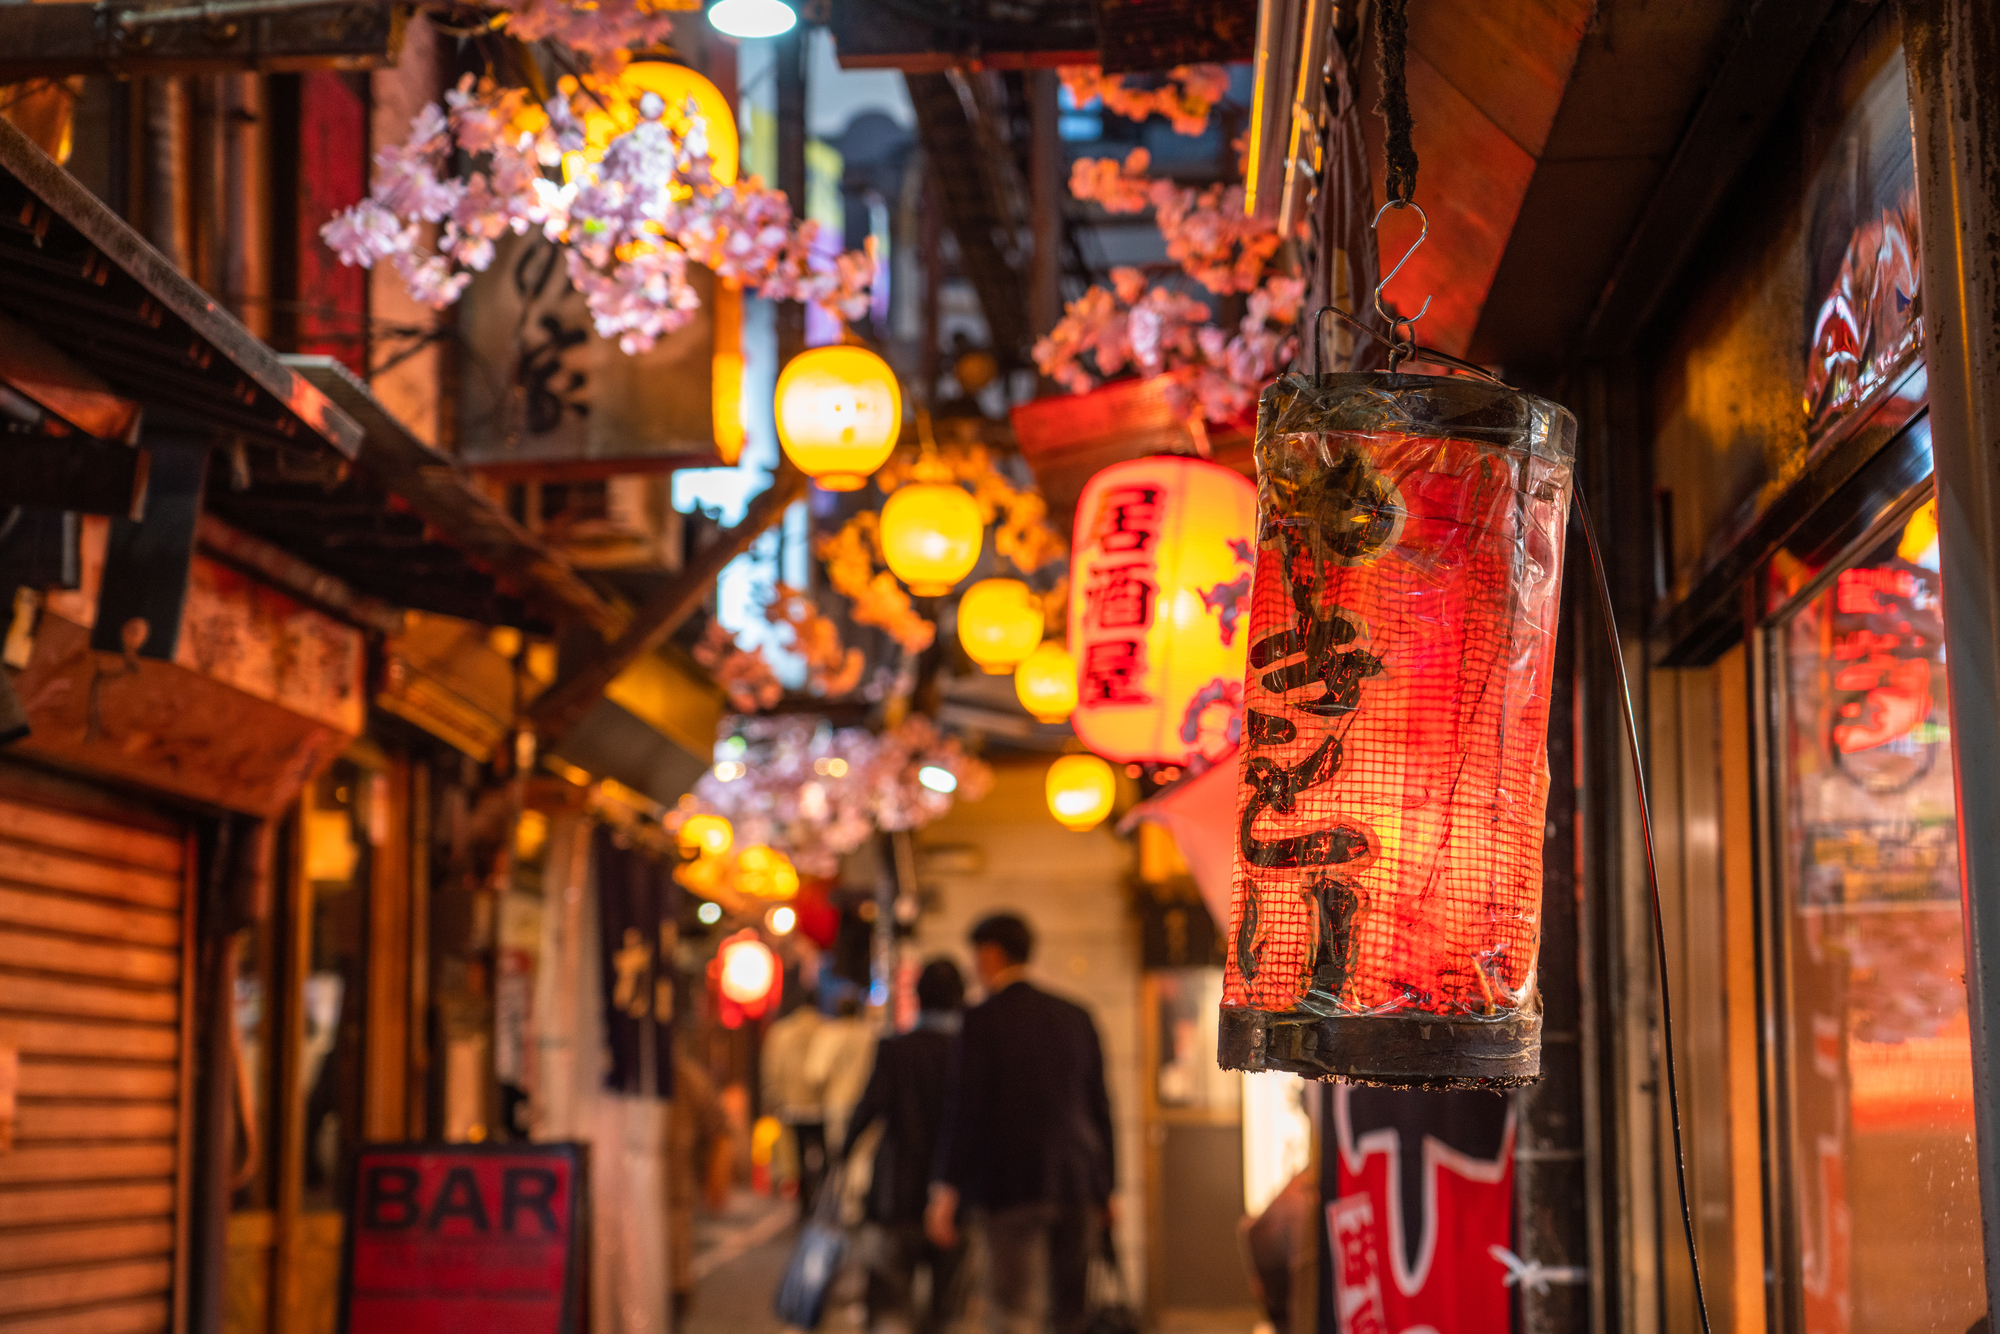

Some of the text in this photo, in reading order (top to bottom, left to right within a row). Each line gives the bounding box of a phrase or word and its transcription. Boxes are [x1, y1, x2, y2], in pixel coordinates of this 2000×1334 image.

[1086, 485, 1160, 706] 居酒屋
[1237, 447, 1397, 1001] やきとり
[364, 1166, 558, 1234] BAR
